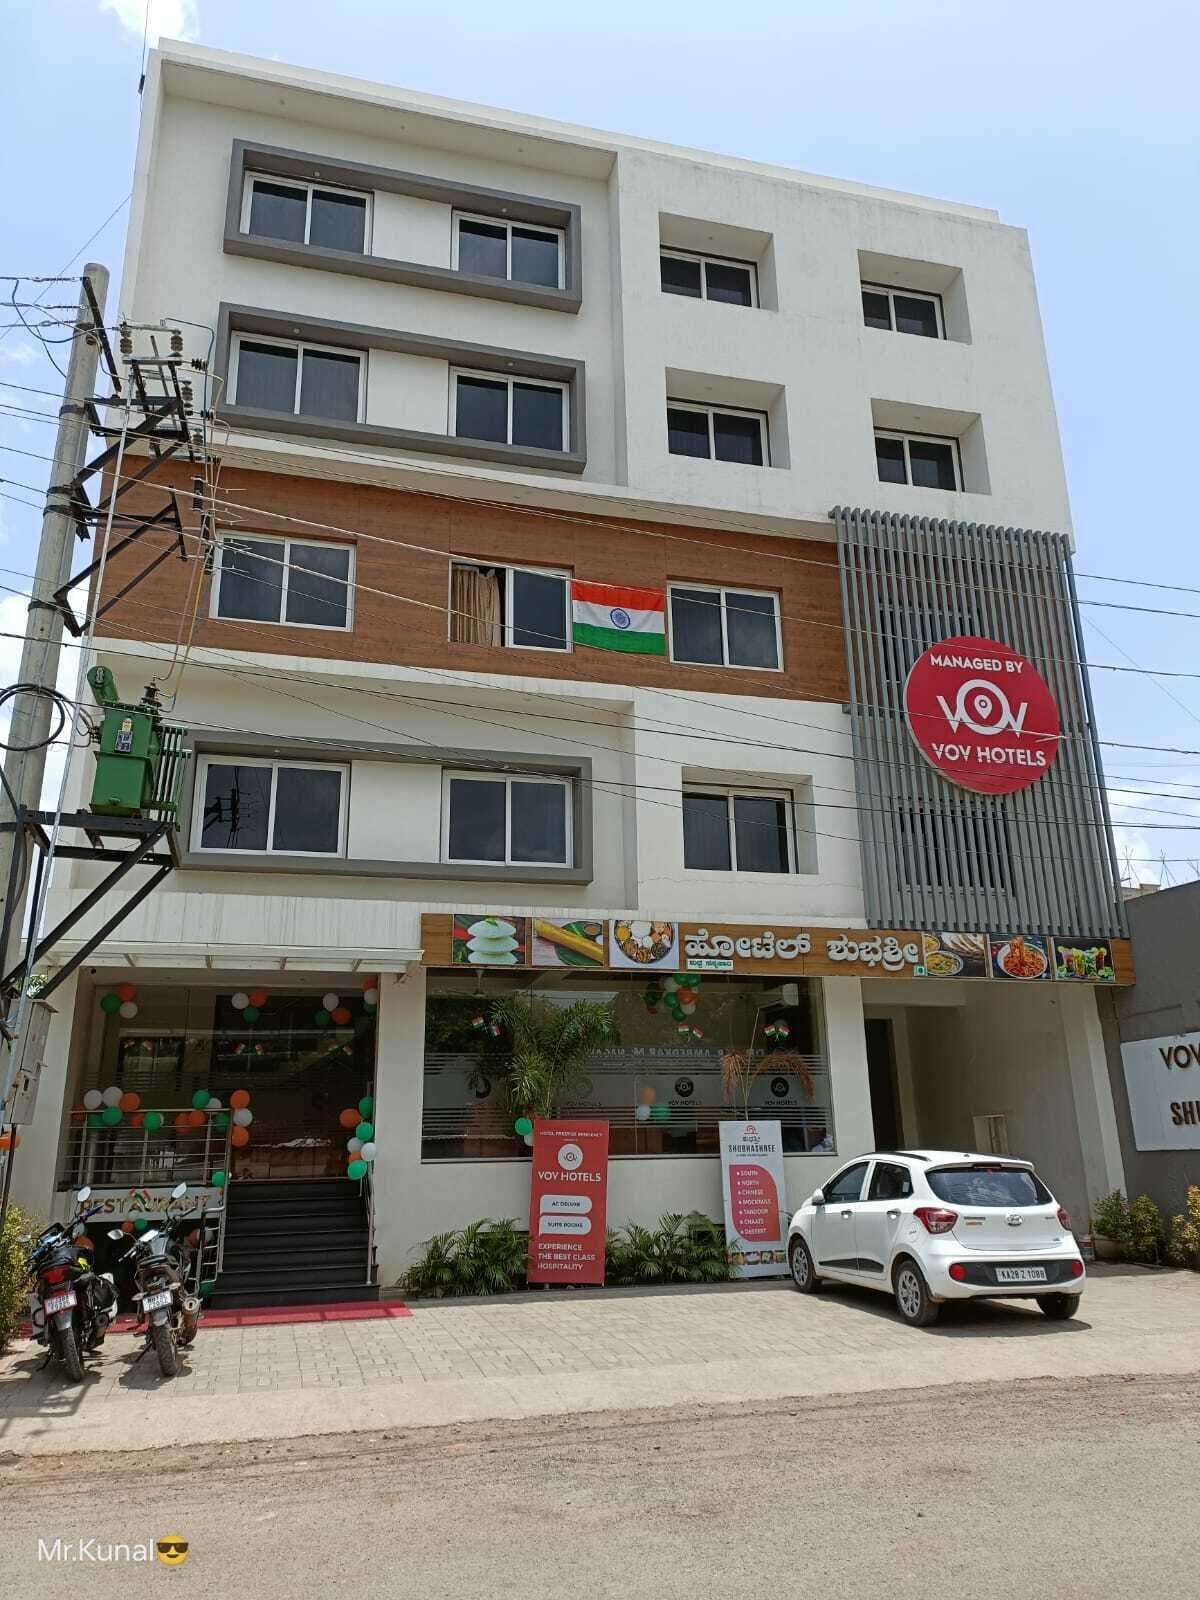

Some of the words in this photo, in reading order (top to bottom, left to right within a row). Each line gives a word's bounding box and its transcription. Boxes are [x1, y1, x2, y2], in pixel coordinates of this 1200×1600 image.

[930, 653, 1002, 673] MANAGED
[1005, 660, 1024, 674] BY
[932, 743, 972, 761] VOV
[977, 745, 1047, 767] HOTELS
[684, 928, 811, 960] ಹೋಟೆಲ್
[826, 933, 920, 972] ಶುಭಶ್ರೀ
[538, 1171, 558, 1181] VOV
[561, 1171, 601, 1182] HOTELS
[538, 1243, 583, 1251] EXPERIENCE
[553, 1253, 571, 1261] BEST
[537, 1263, 584, 1271] HOSPITALITY
